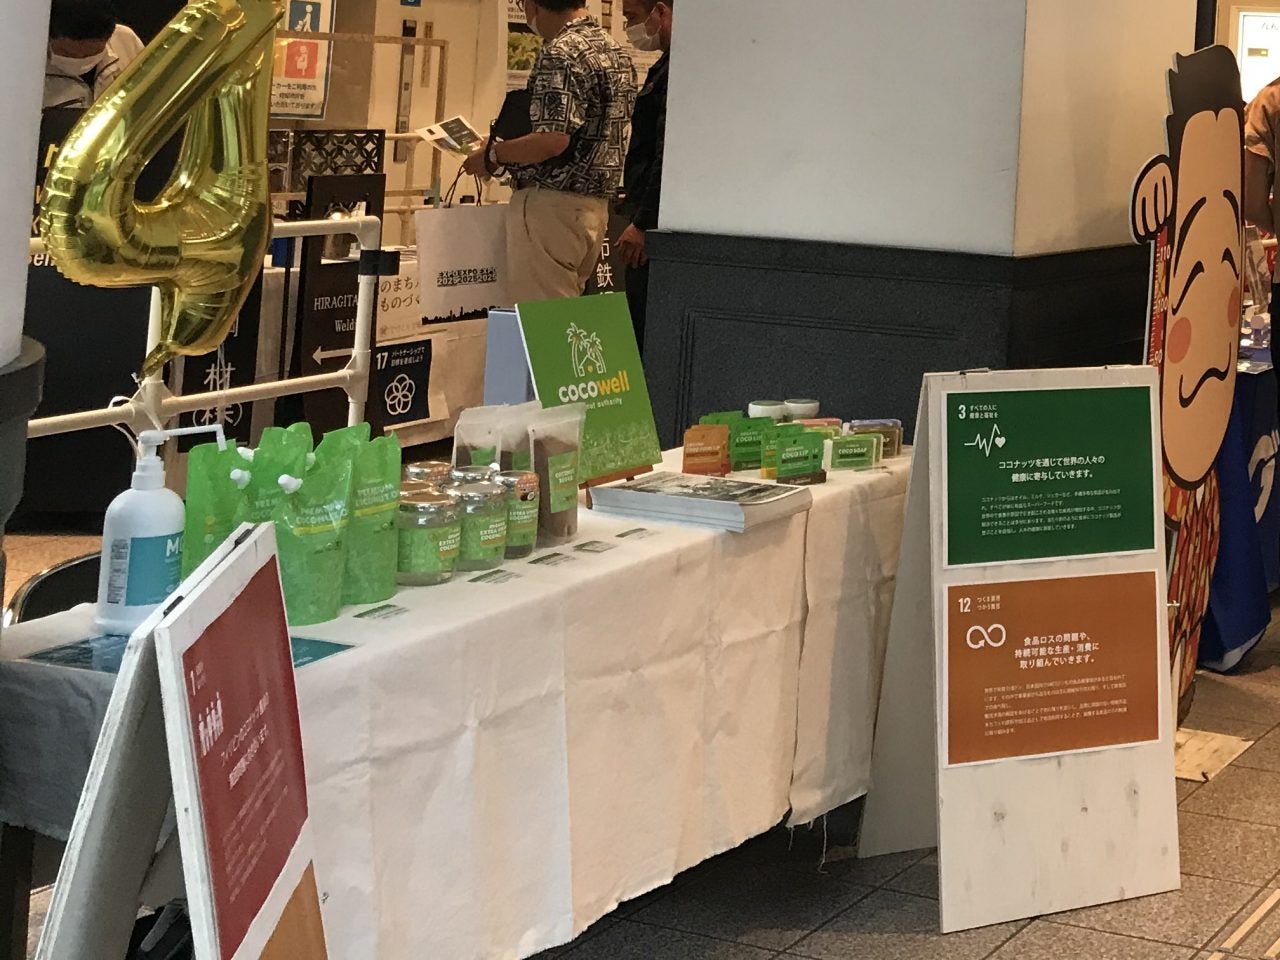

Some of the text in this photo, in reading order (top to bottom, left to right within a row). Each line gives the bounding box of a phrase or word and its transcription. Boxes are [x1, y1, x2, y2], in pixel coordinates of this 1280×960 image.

[334, 318, 357, 332] Weld
[376, 351, 389, 370] 17
[558, 370, 630, 403] cocowell
[958, 404, 966, 419] 3
[781, 451, 799, 459] COCO
[999, 455, 1105, 470] ココナッツを通じて世界の人々の
[1011, 469, 1094, 483] 健康に寄与していきます。
[958, 597, 971, 613] 12
[1023, 632, 1091, 647] 食品ロスの問題や、
[1014, 642, 1100, 659] 持続可能な生産・消費に
[1019, 654, 1096, 670] 取り組んでいきます。
